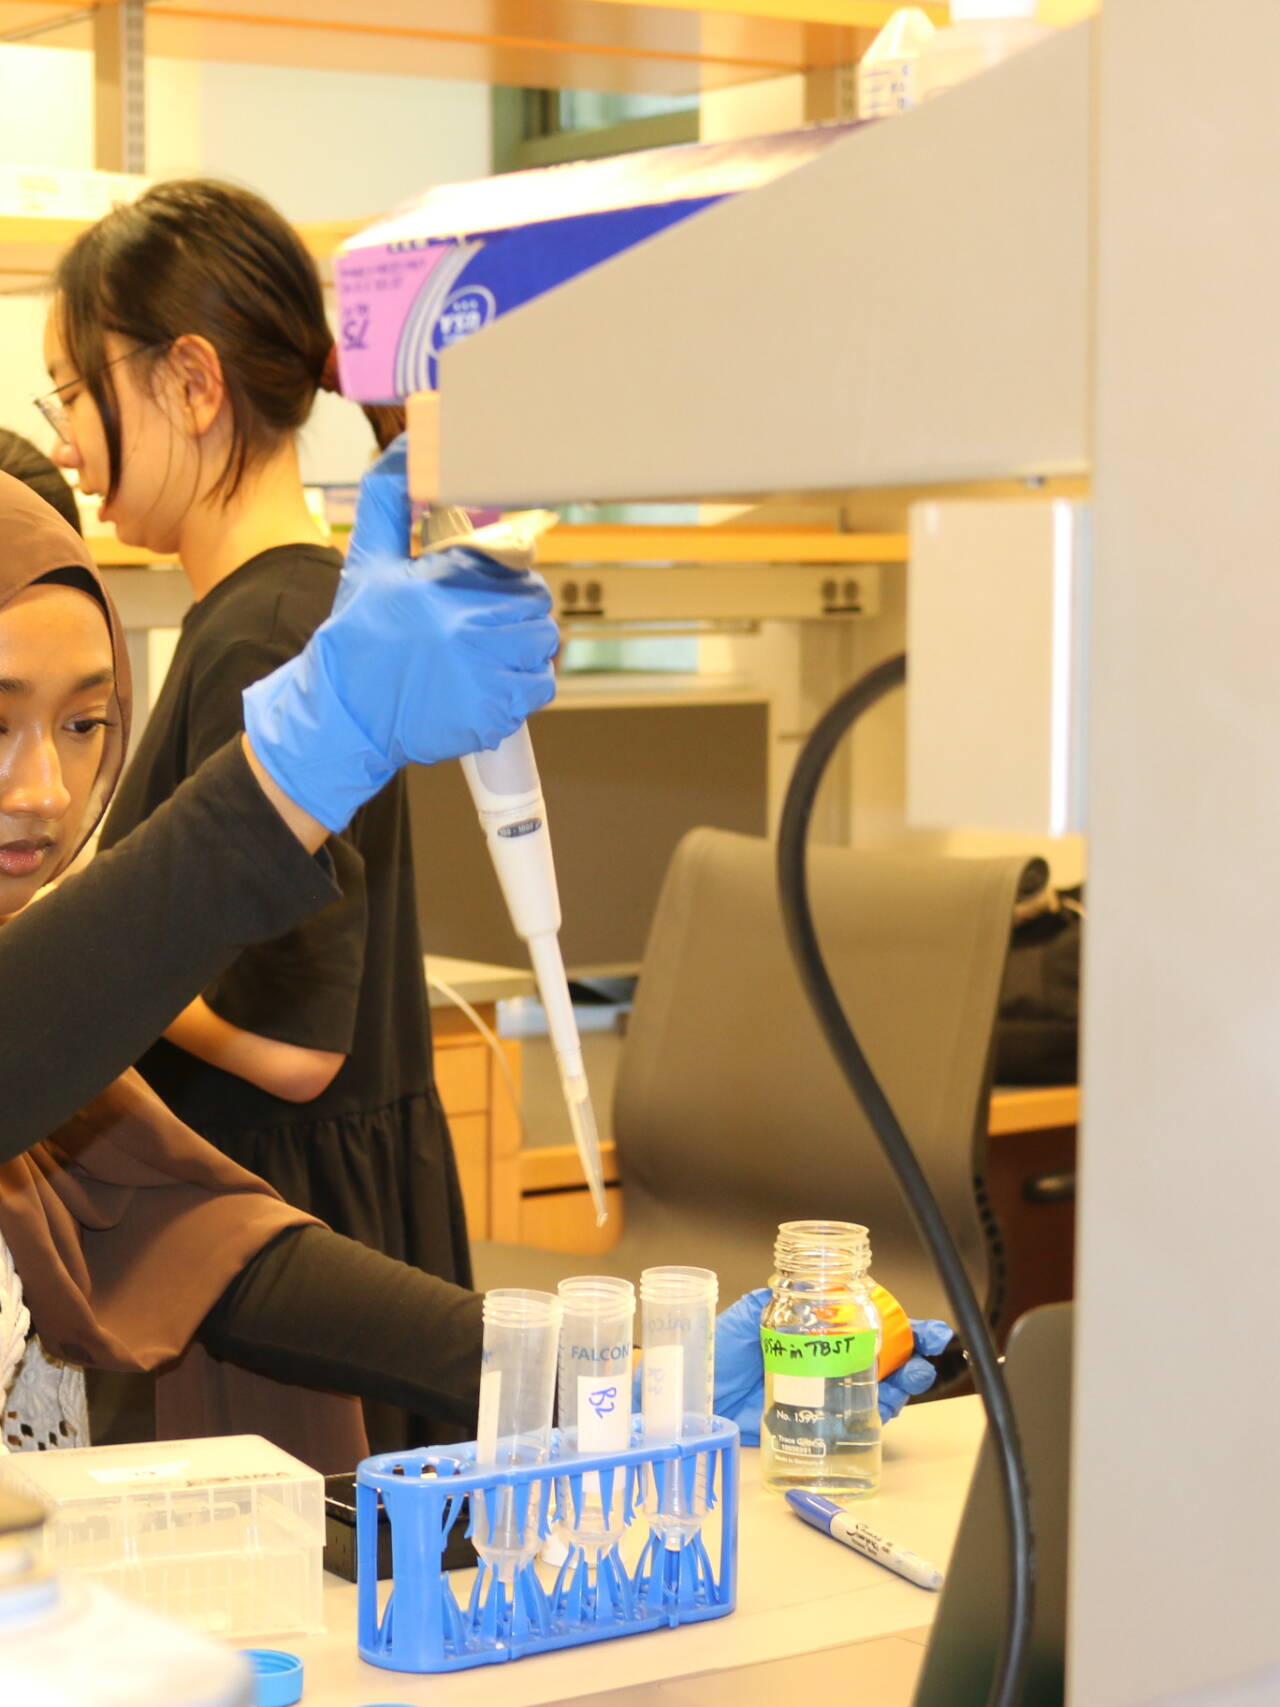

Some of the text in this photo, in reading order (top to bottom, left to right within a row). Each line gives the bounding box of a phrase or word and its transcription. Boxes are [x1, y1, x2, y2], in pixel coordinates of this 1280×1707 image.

[343, 318, 368, 351] 75
[571, 1344, 630, 1361] FALCON
[790, 1344, 803, 1359] in
[804, 1336, 855, 1357] TBST
[588, 1386, 617, 1419] B2
[776, 1409, 791, 1422] No.
